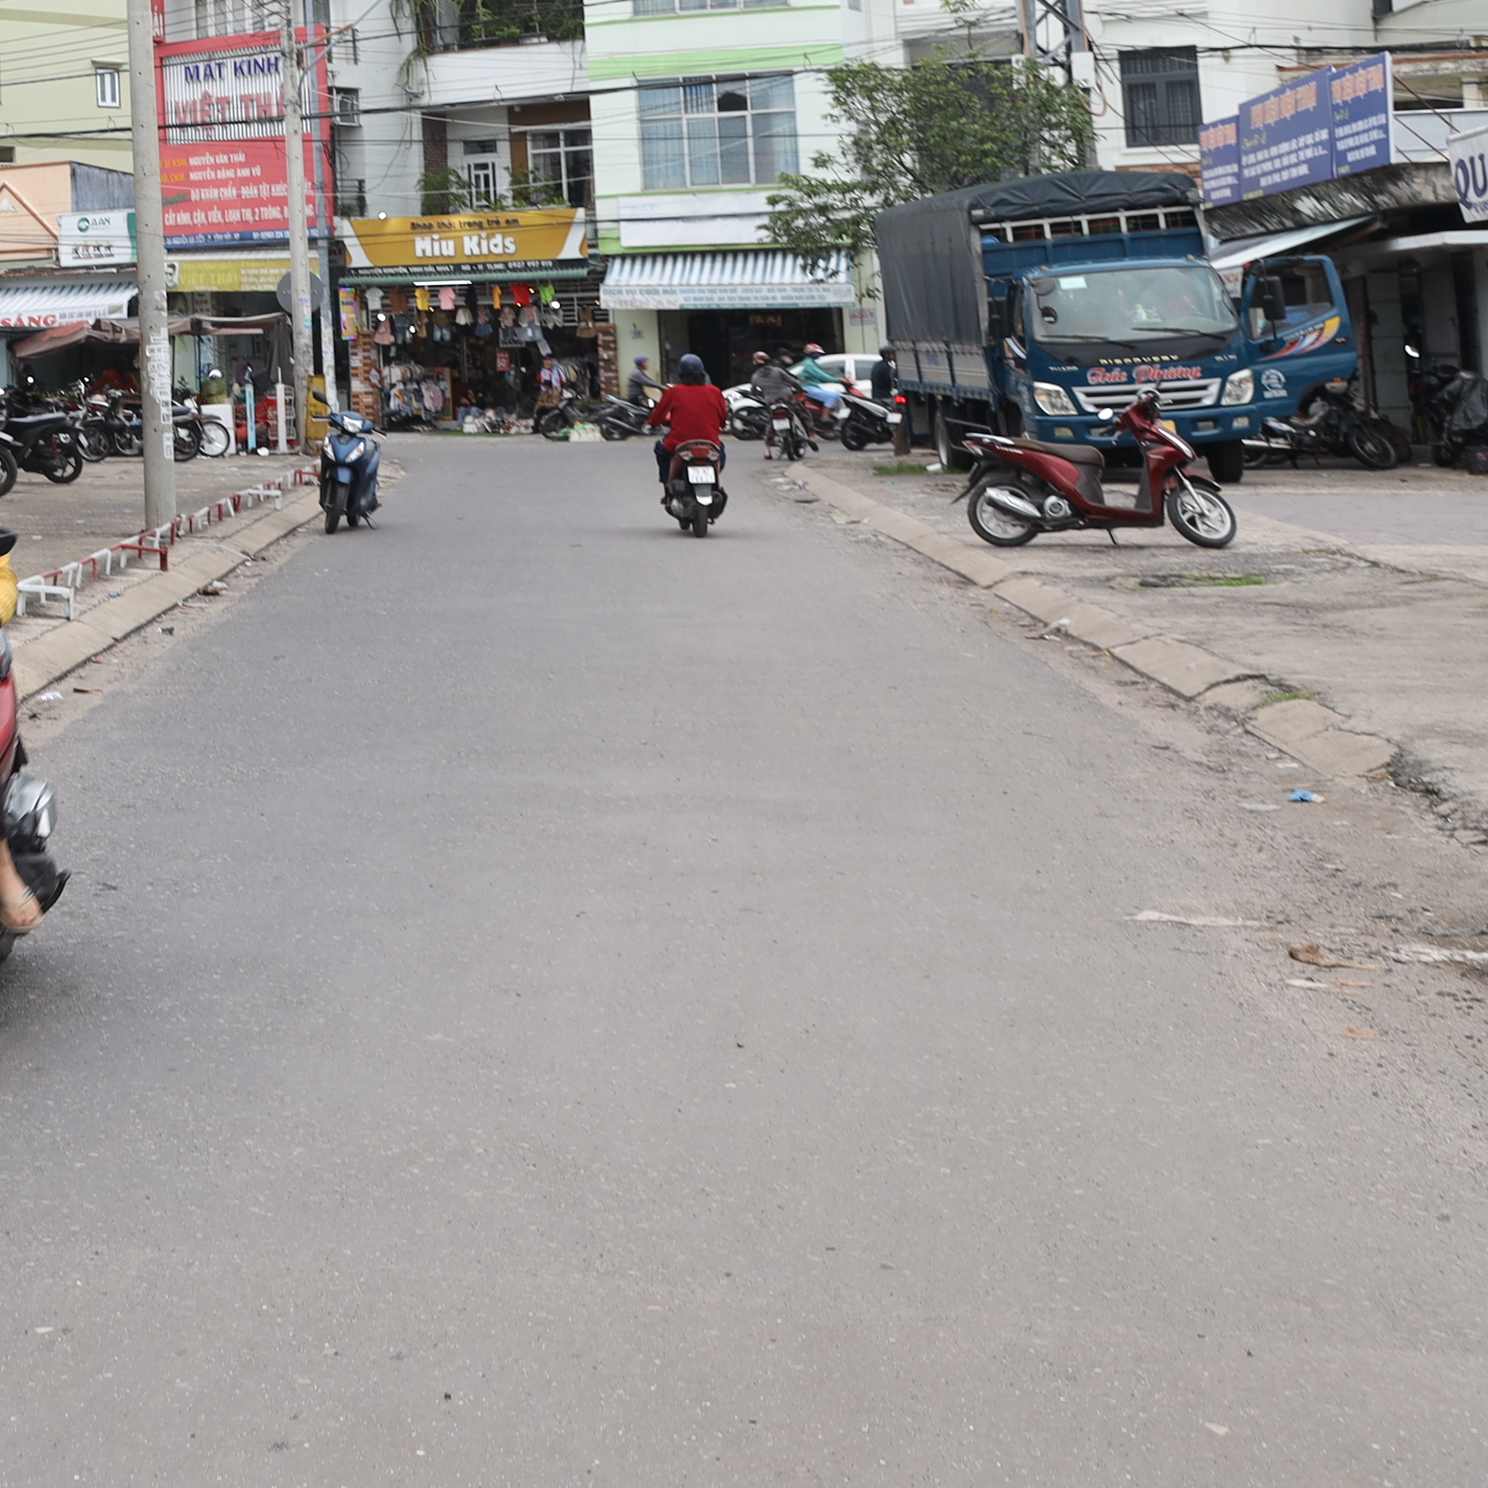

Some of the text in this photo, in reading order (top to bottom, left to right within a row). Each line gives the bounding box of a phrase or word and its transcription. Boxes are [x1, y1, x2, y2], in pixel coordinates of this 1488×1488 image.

[410, 221, 434, 230] Shop
[460, 219, 485, 230] trang
[463, 232, 516, 256] Kids
